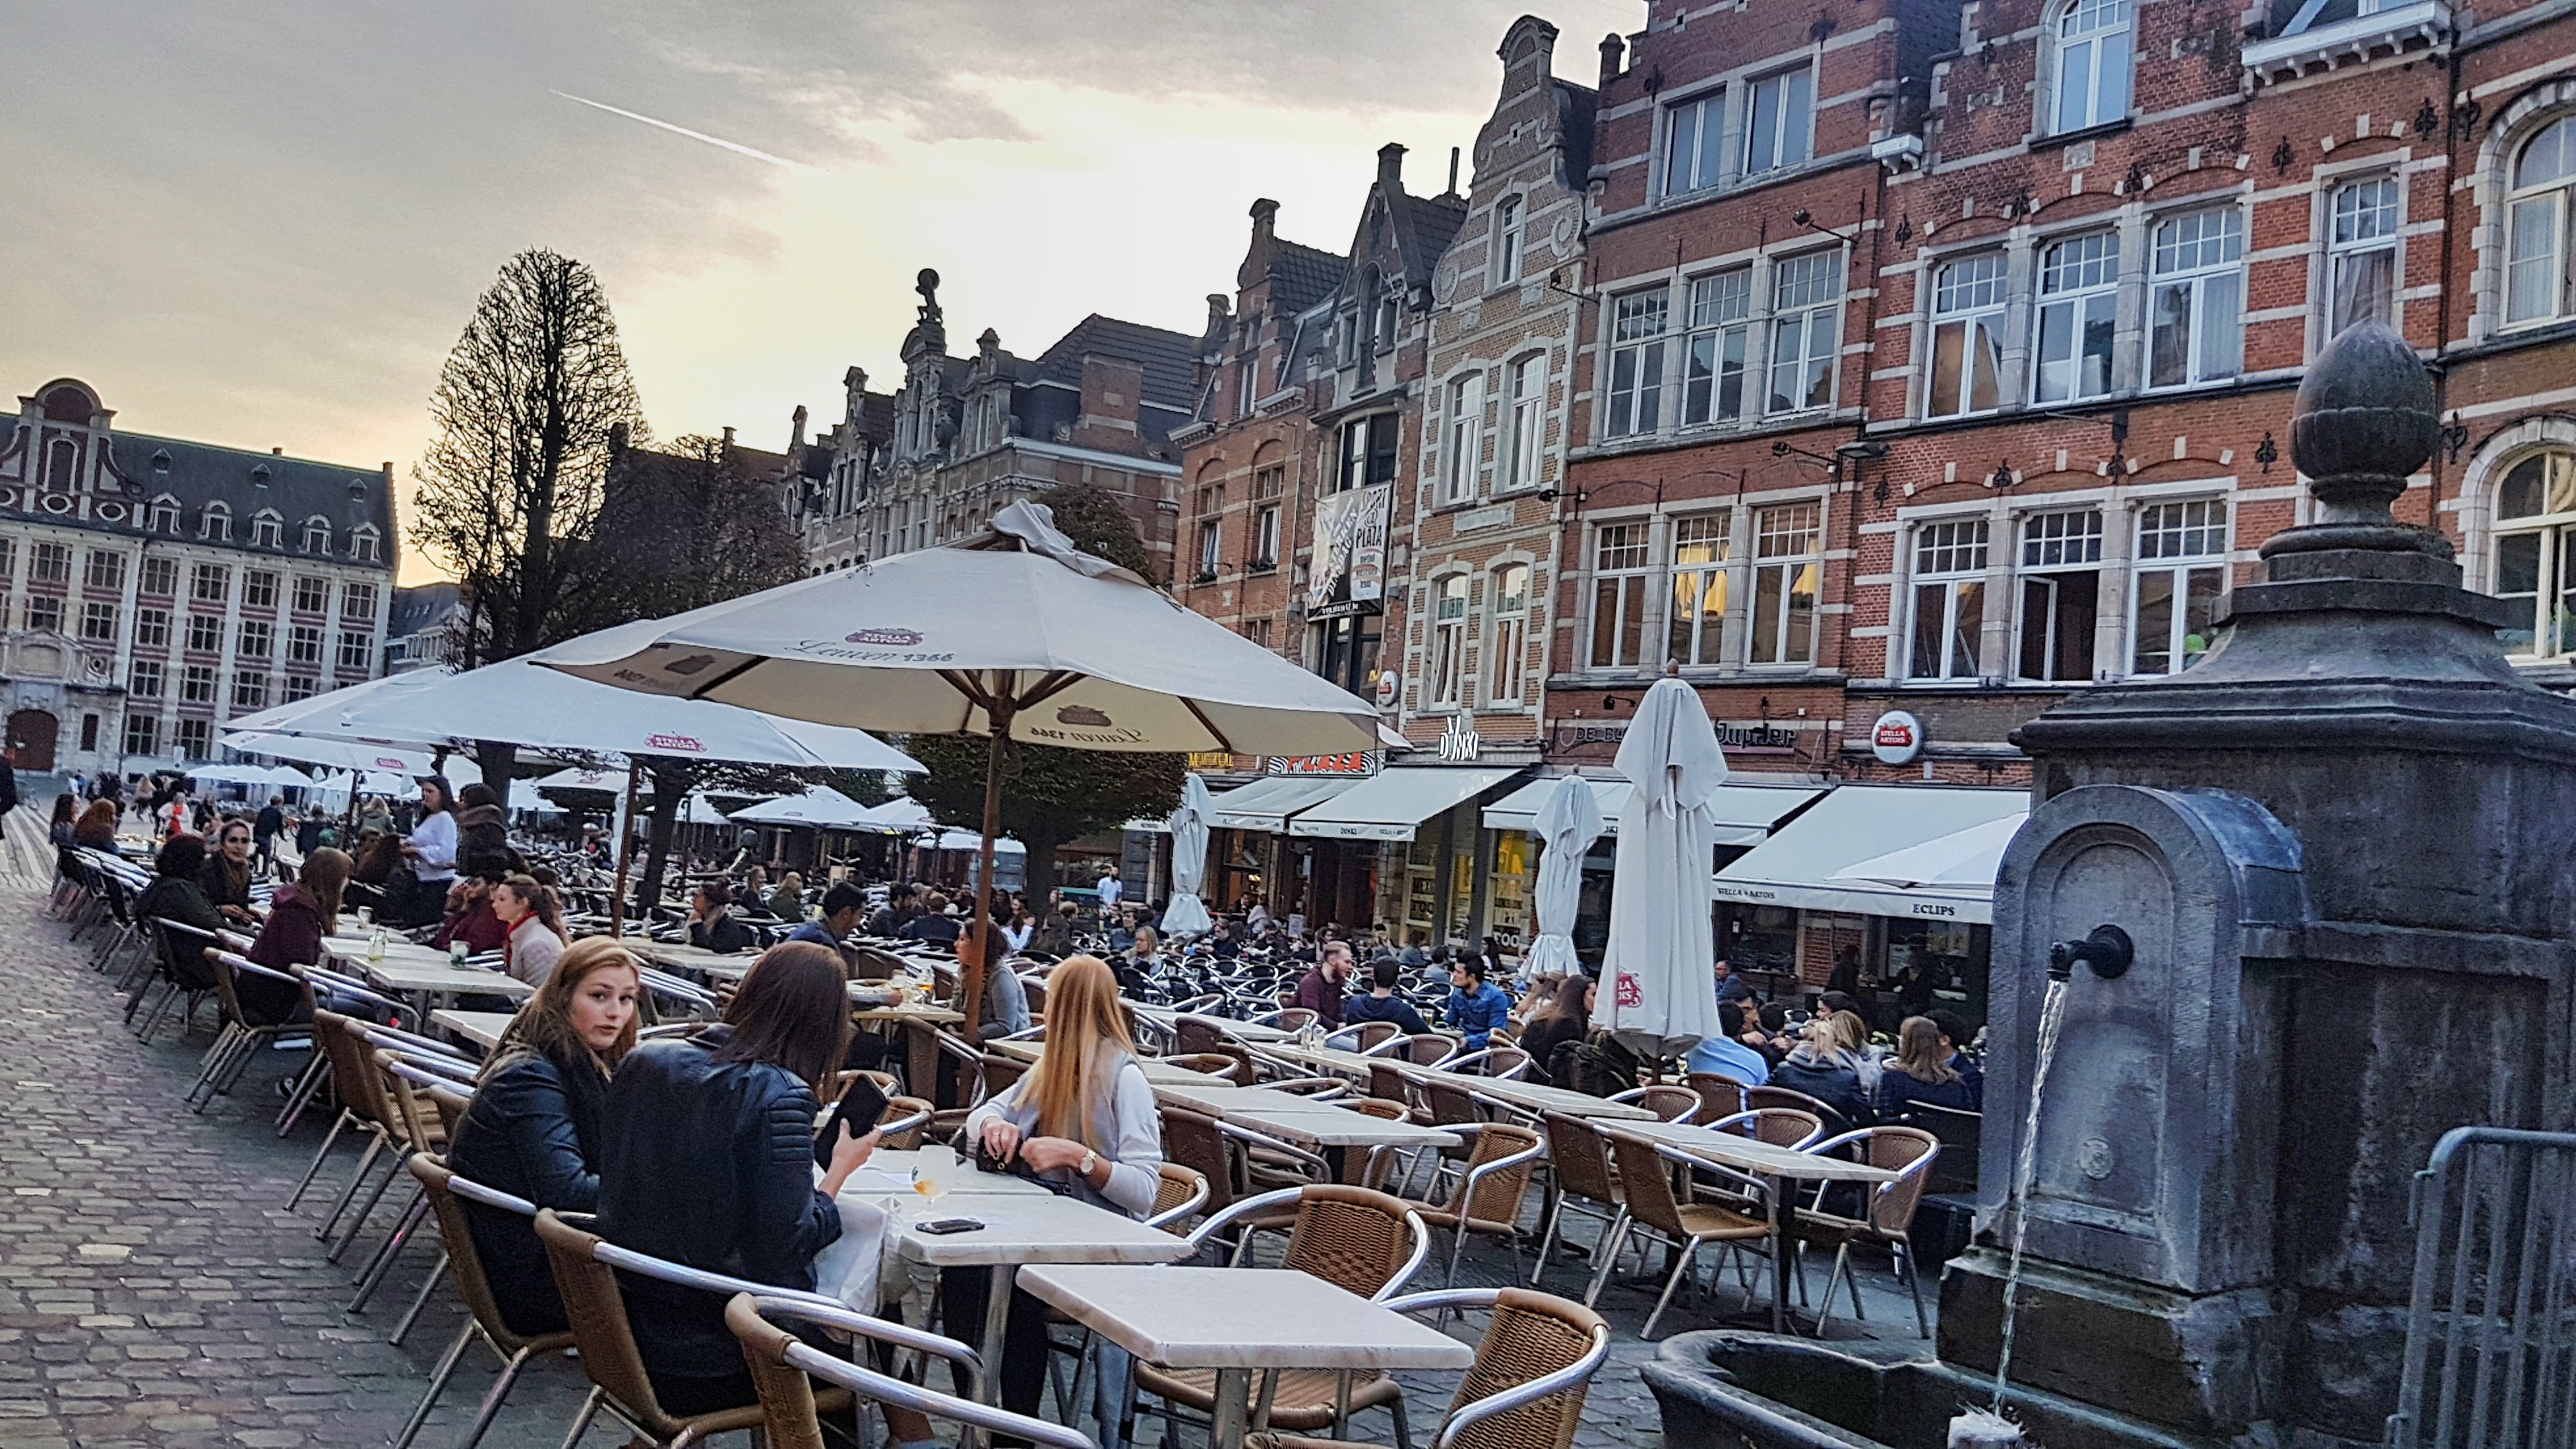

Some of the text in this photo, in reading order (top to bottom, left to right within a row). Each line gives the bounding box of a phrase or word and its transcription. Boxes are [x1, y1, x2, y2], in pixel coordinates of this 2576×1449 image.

[1356, 525, 1382, 549] PLAZA
[903, 652, 954, 662] 1366
[1576, 727, 1595, 740] DE
[1717, 887, 1955, 916] STELLA ARTOIS ECLIPS
